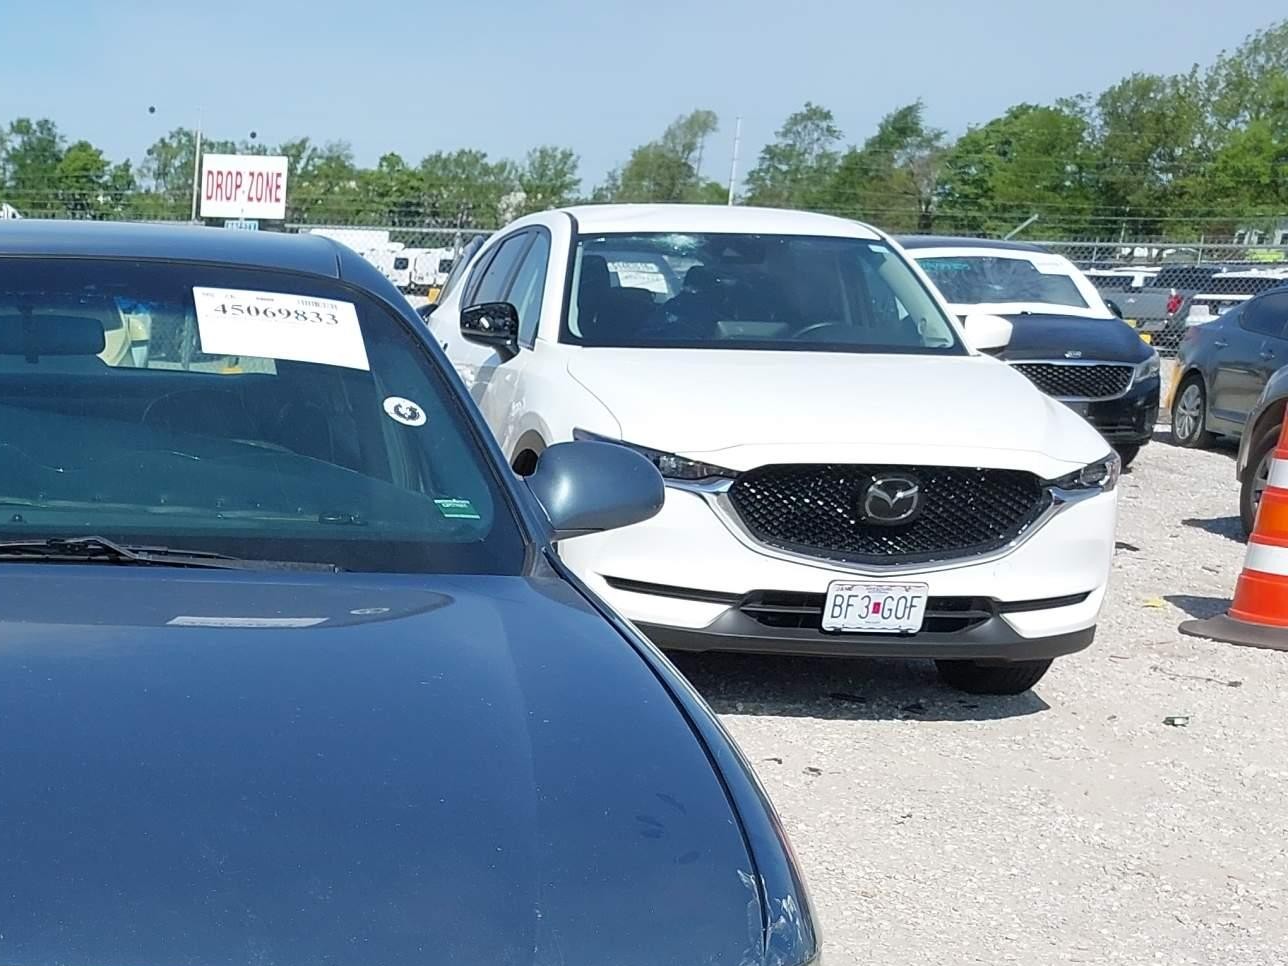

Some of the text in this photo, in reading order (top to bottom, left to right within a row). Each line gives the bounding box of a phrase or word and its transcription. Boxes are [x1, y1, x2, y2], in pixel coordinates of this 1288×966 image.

[206, 170, 282, 203] DROP ZONE
[213, 303, 339, 325] 45069833
